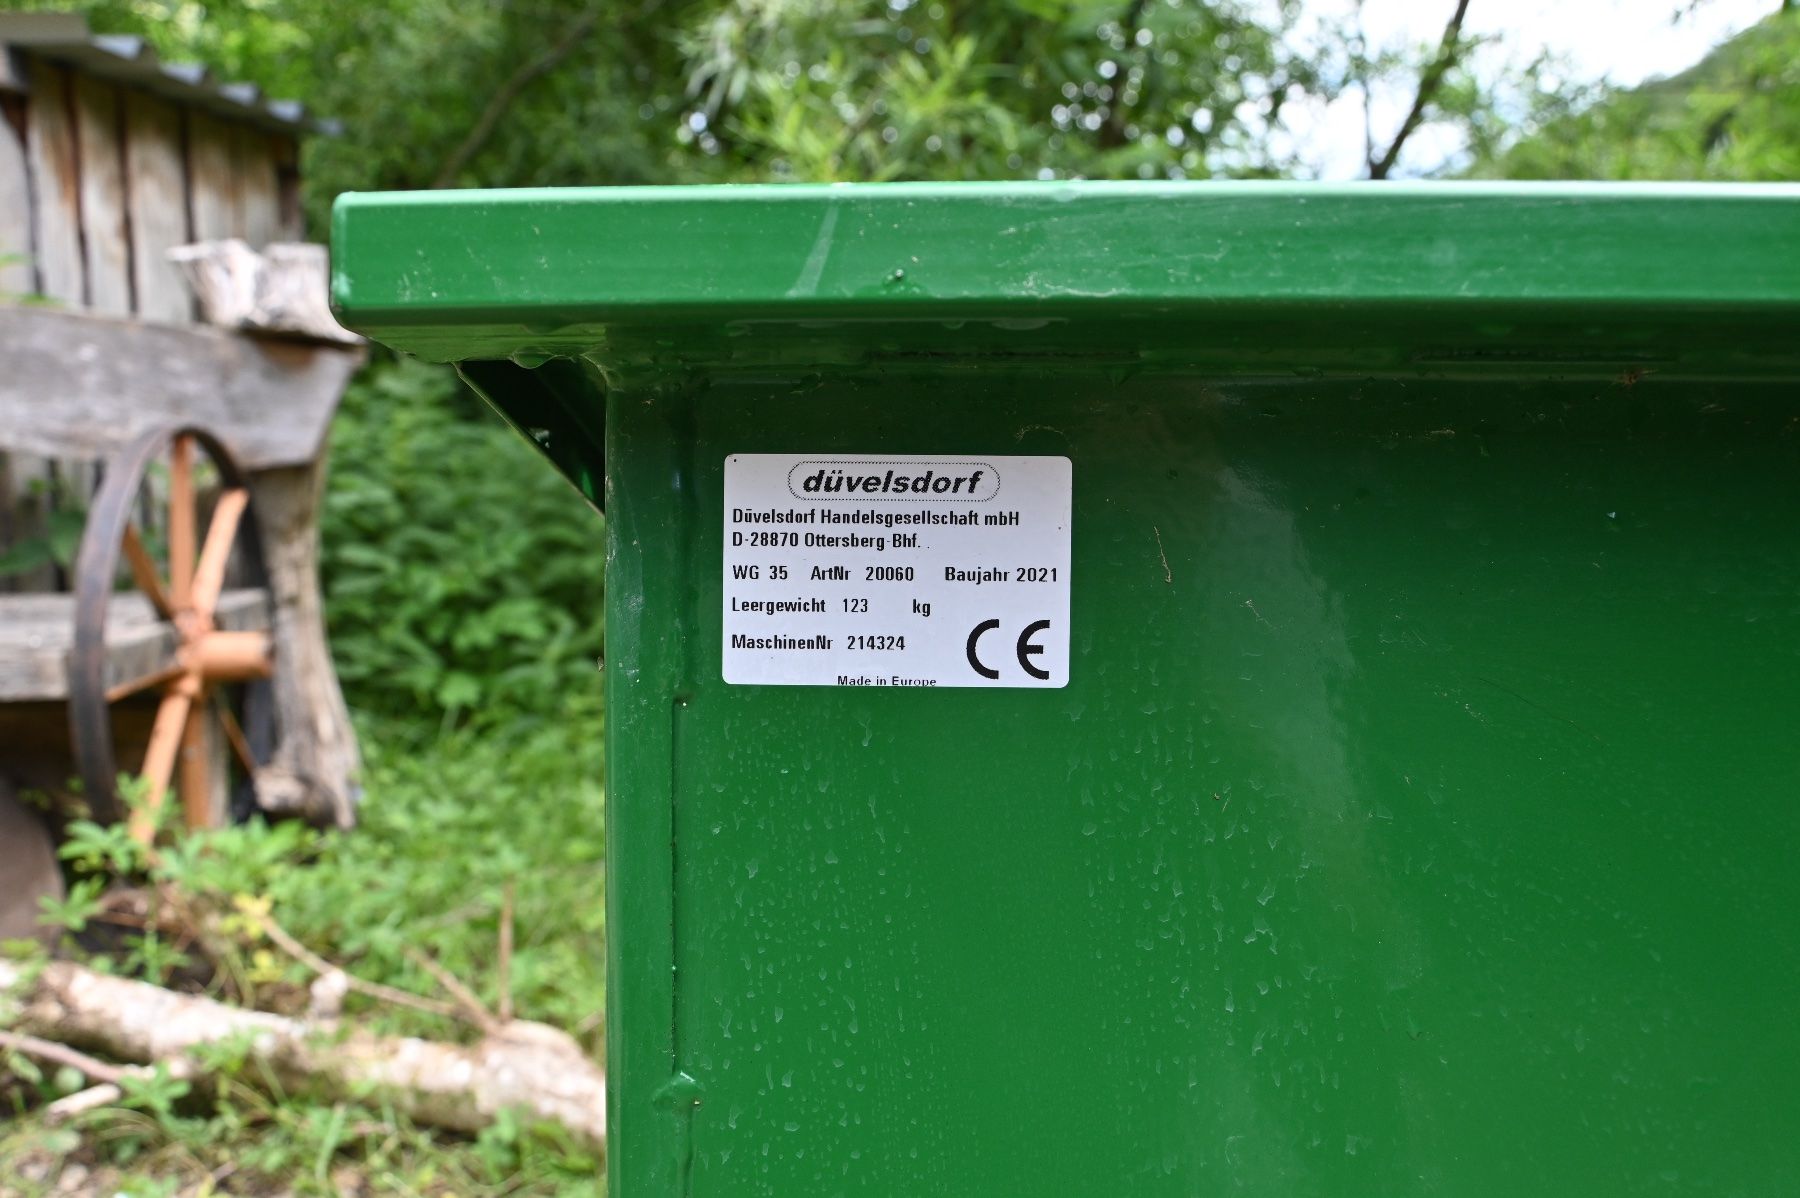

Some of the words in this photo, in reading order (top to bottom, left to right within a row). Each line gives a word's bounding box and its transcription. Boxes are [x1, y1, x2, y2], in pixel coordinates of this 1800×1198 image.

[803, 469, 984, 494] düvelsdorf
[733, 508, 815, 525] Düvelsdorf
[821, 510, 979, 528] Handelsgesellschaft
[984, 512, 1019, 526] mbH
[733, 532, 798, 547] D-28870
[733, 565, 760, 580] WG
[769, 565, 788, 580] 35
[811, 566, 852, 581] ArtNr
[865, 566, 914, 582] 20060
[944, 567, 1010, 585] Baujahr
[1016, 567, 1057, 583] 2021
[732, 597, 826, 616] Leergewicht
[843, 598, 868, 613] 123
[912, 599, 931, 617] kg
[732, 634, 833, 650] MaschinenNr
[847, 635, 906, 651] 214324
[837, 675, 872, 686] Made
[876, 675, 887, 686] in
[891, 676, 937, 687] Europe
